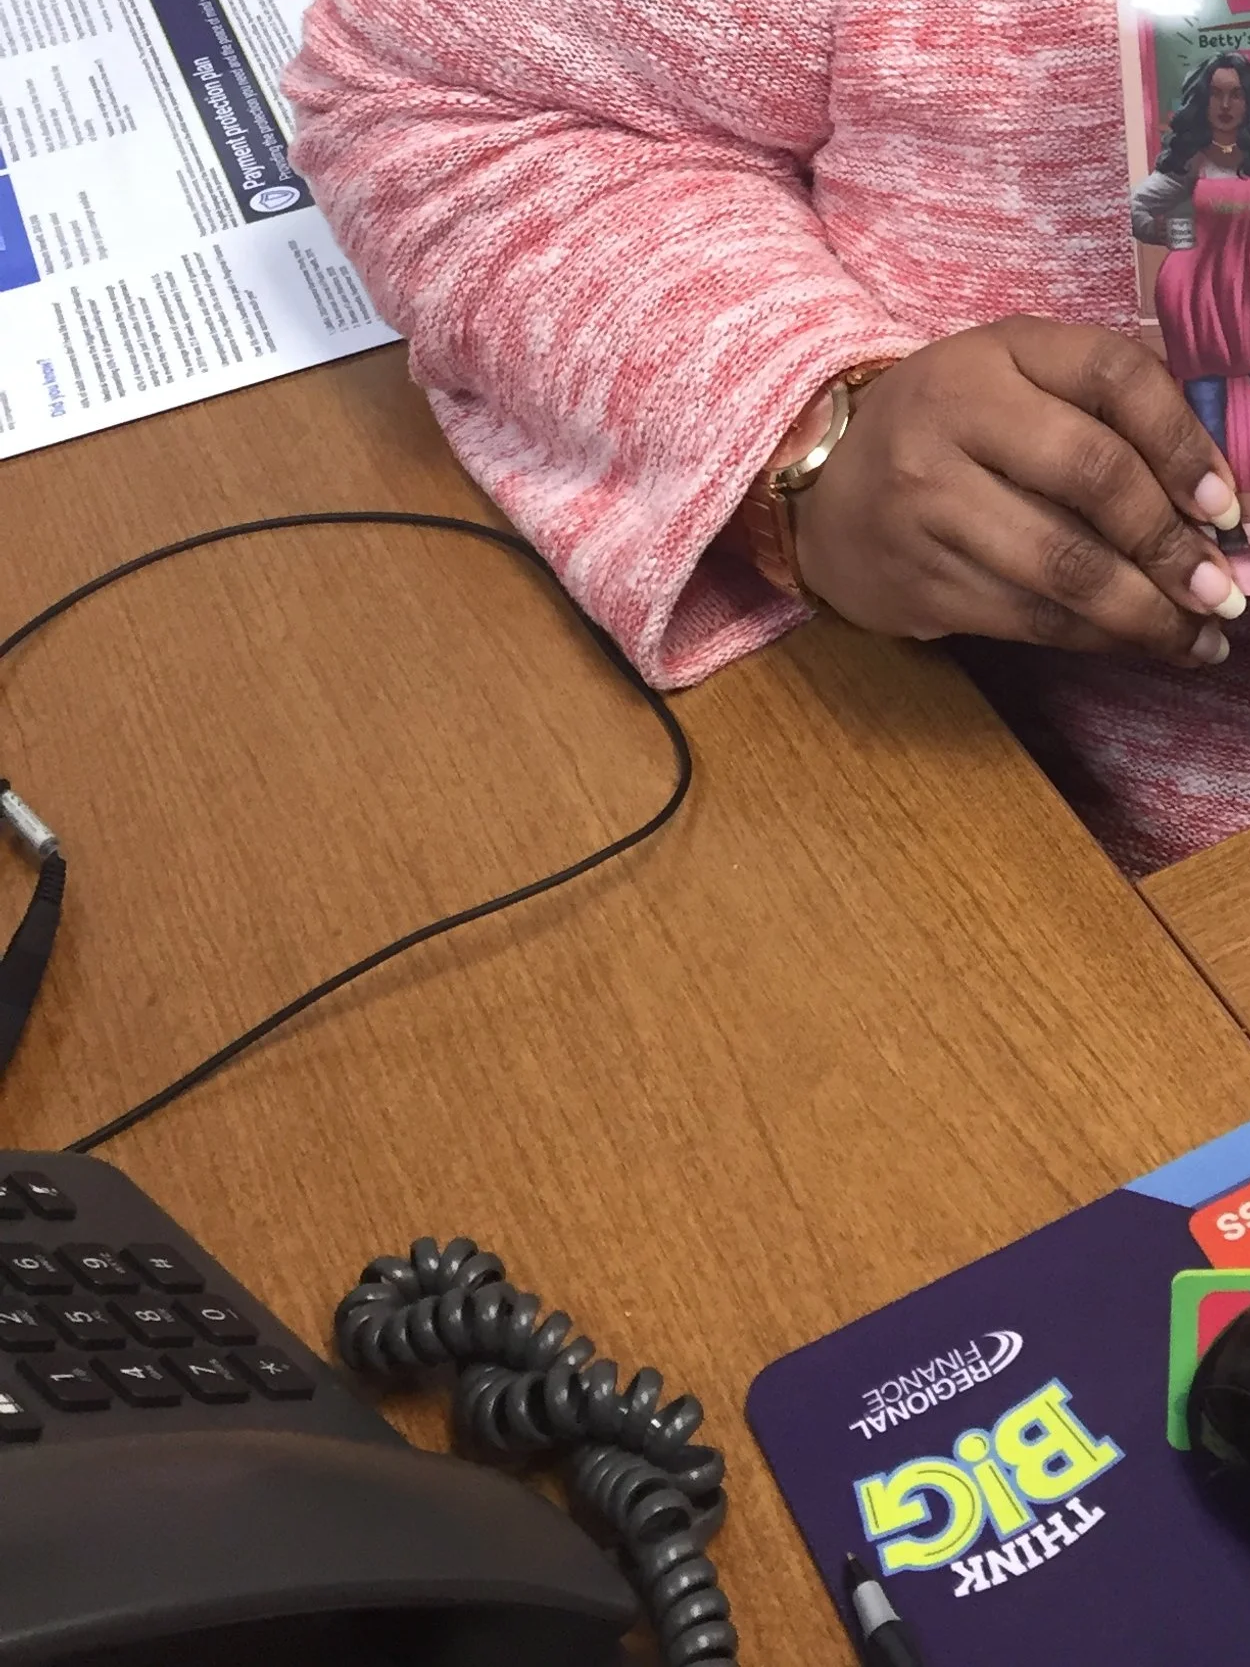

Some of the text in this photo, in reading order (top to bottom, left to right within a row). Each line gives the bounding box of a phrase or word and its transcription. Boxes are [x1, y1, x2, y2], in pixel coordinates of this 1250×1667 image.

[206, 17, 220, 25] of
[221, 44, 235, 56] the
[193, 56, 221, 81] plan
[224, 55, 241, 68] and
[230, 68, 249, 86] need
[241, 85, 256, 99] you
[205, 81, 247, 136] protection
[247, 98, 272, 133] protection
[262, 133, 277, 146] the
[226, 136, 265, 190] Payment
[12, 1257, 40, 1270] 6
[82, 1256, 109, 1270] 9
[64, 1310, 93, 1323] 5
[135, 1310, 161, 1322] 8
[120, 1366, 146, 1379] 4
[188, 1363, 216, 1375] 7
[862, 1340, 982, 1413] FINANCE
[849, 1359, 993, 1440] REGIONAL
[950, 1497, 1106, 1598] THINK
